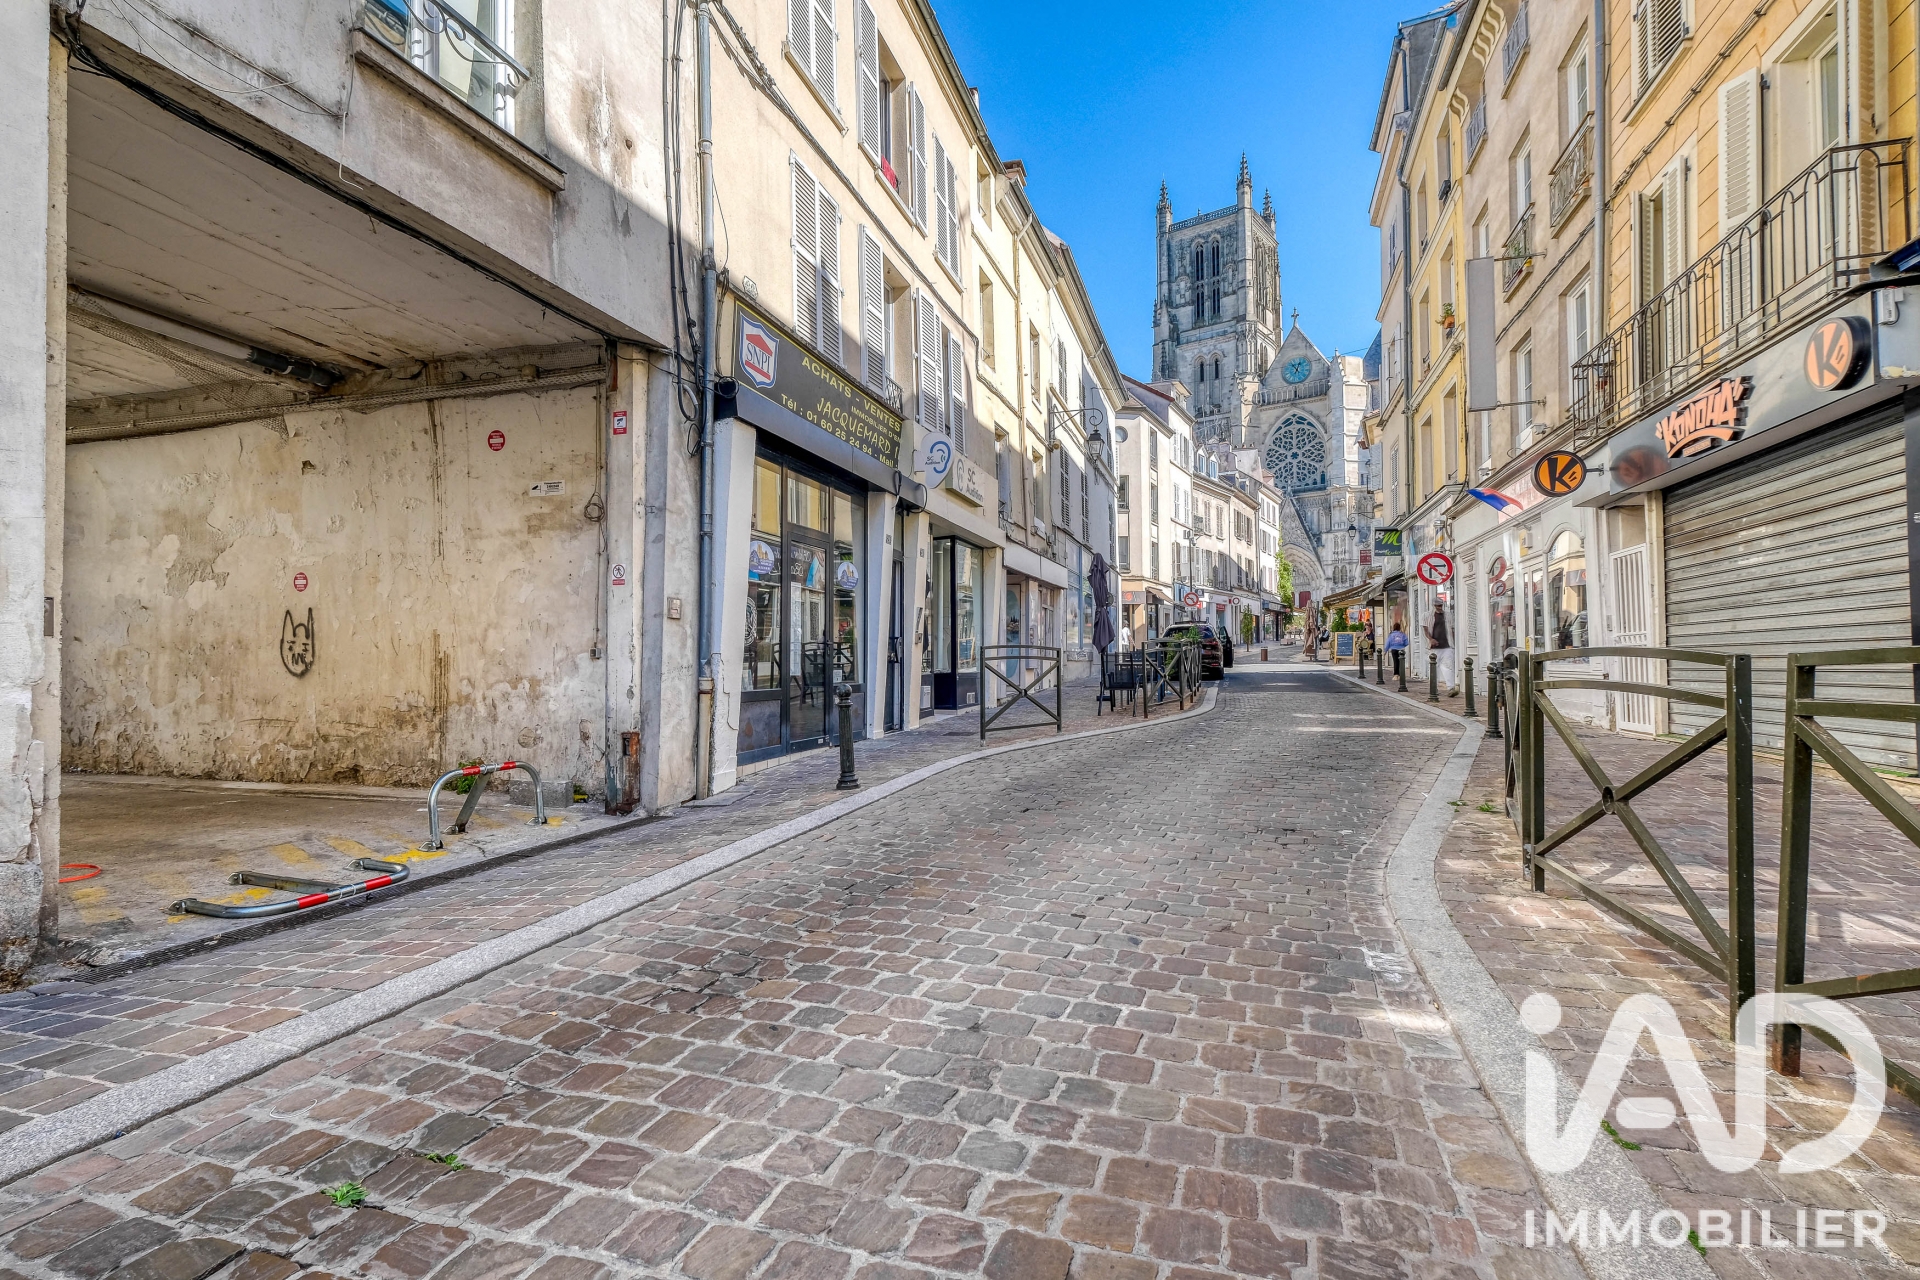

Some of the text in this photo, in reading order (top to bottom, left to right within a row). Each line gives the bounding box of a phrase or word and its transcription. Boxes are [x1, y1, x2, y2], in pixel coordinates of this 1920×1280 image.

[746, 342, 771, 374] SNPI
[802, 357, 852, 398] ACHATS
[863, 398, 901, 432] VENTES
[851, 405, 888, 435] IMMOBILIER
[1660, 380, 1738, 454] KONOHA
[781, 393, 797, 412] Tél
[806, 410, 818, 424] 01
[820, 419, 833, 433] 60
[835, 428, 847, 441] 25
[849, 436, 860, 449] 24
[862, 444, 872, 456] 94
[879, 453, 894, 468] Mail
[817, 397, 891, 454] JACQUEMARD
[967, 467, 976, 486] SC
